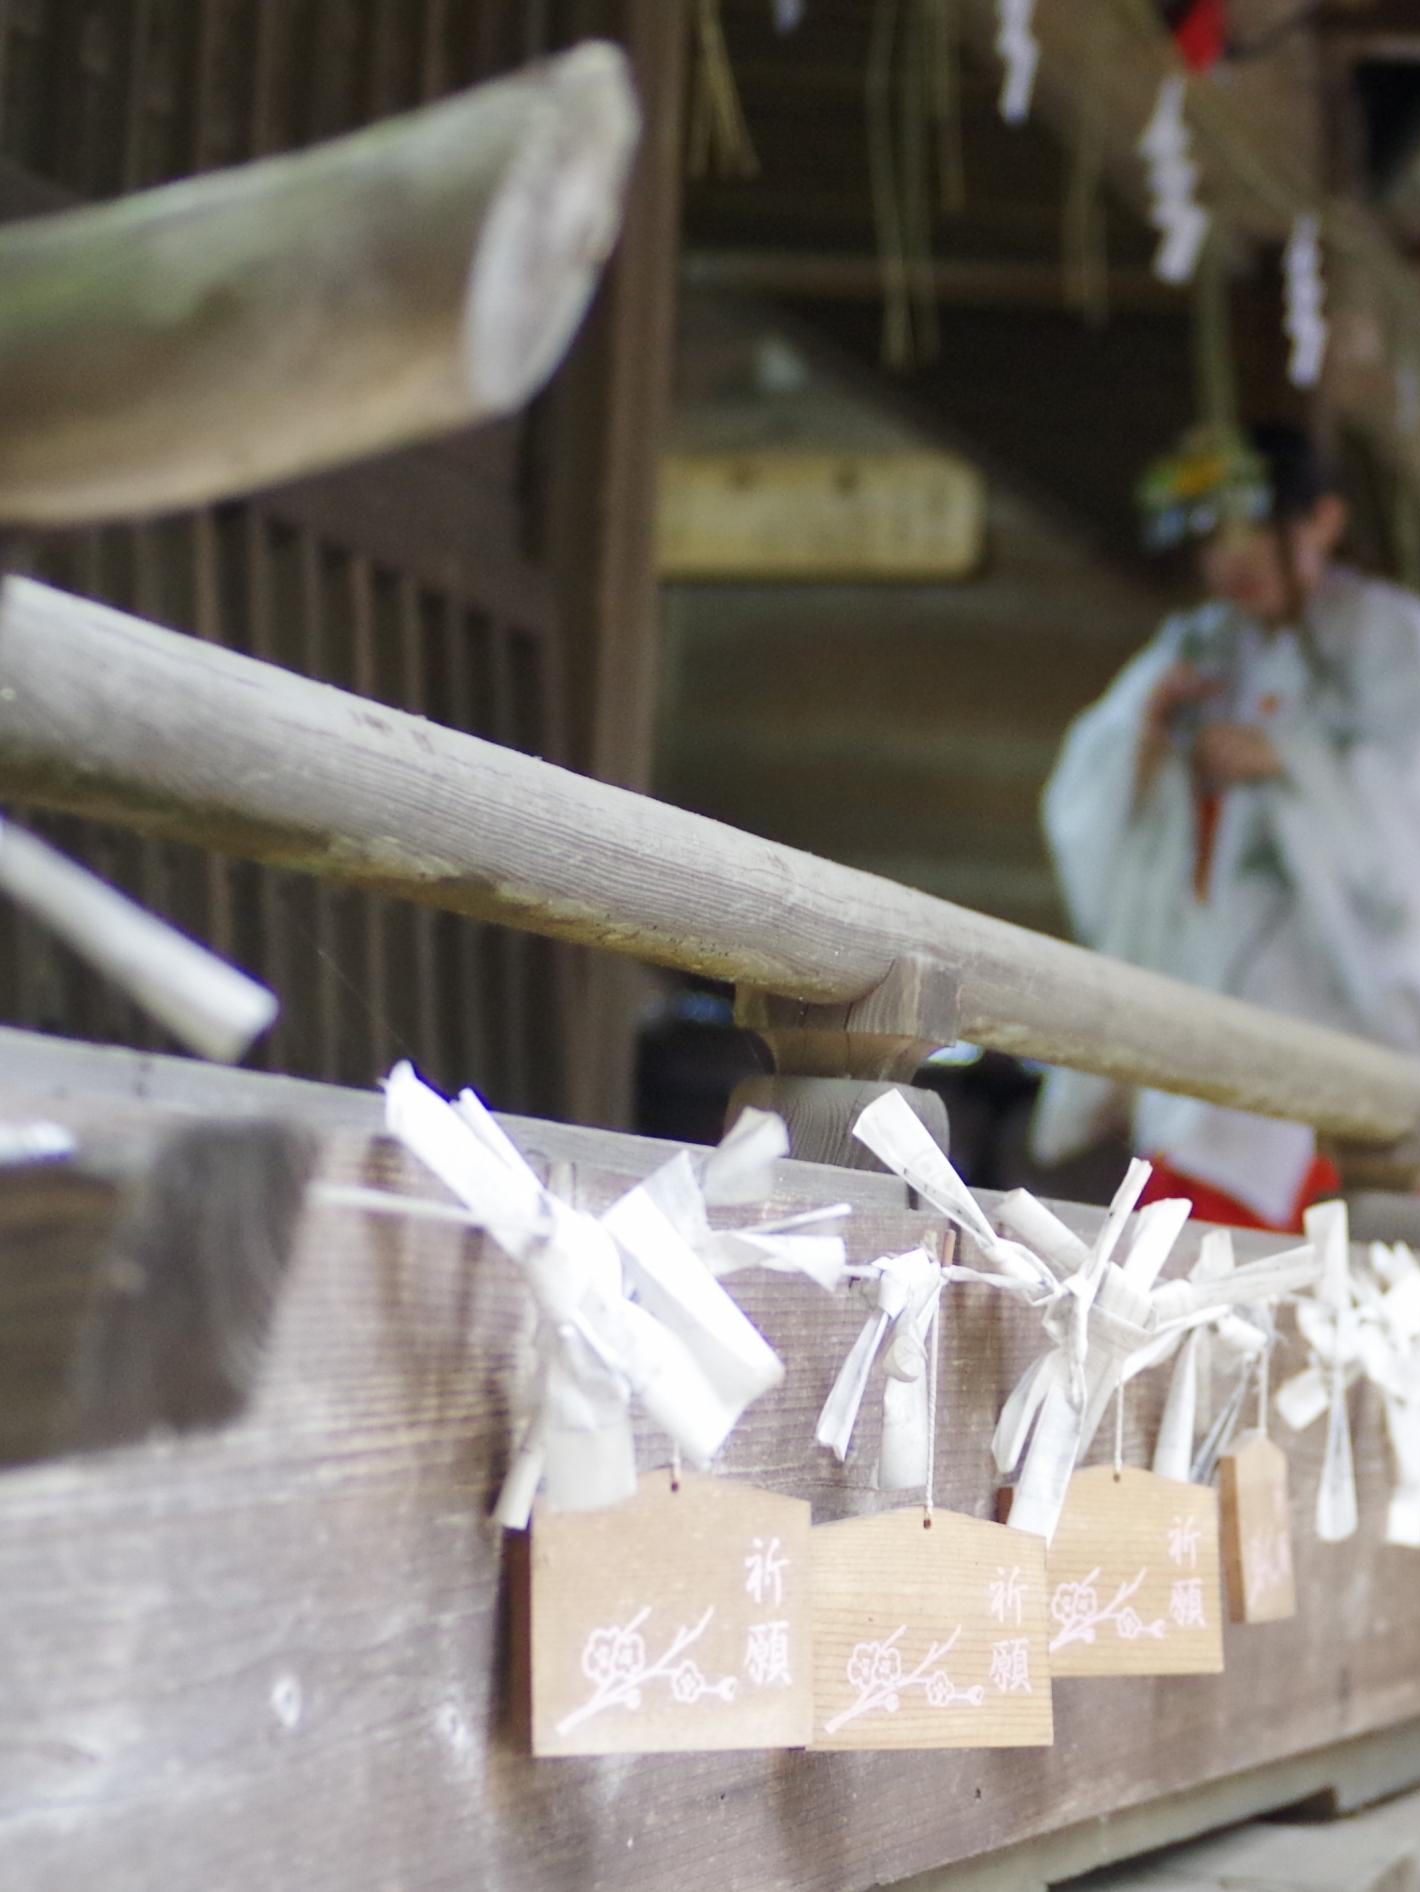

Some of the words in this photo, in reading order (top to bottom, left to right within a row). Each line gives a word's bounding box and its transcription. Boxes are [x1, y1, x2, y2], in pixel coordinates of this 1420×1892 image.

[744, 1537, 789, 1684] 祈願
[990, 1566, 1032, 1692] 祈願
[1168, 1516, 1206, 1627] 祈願
